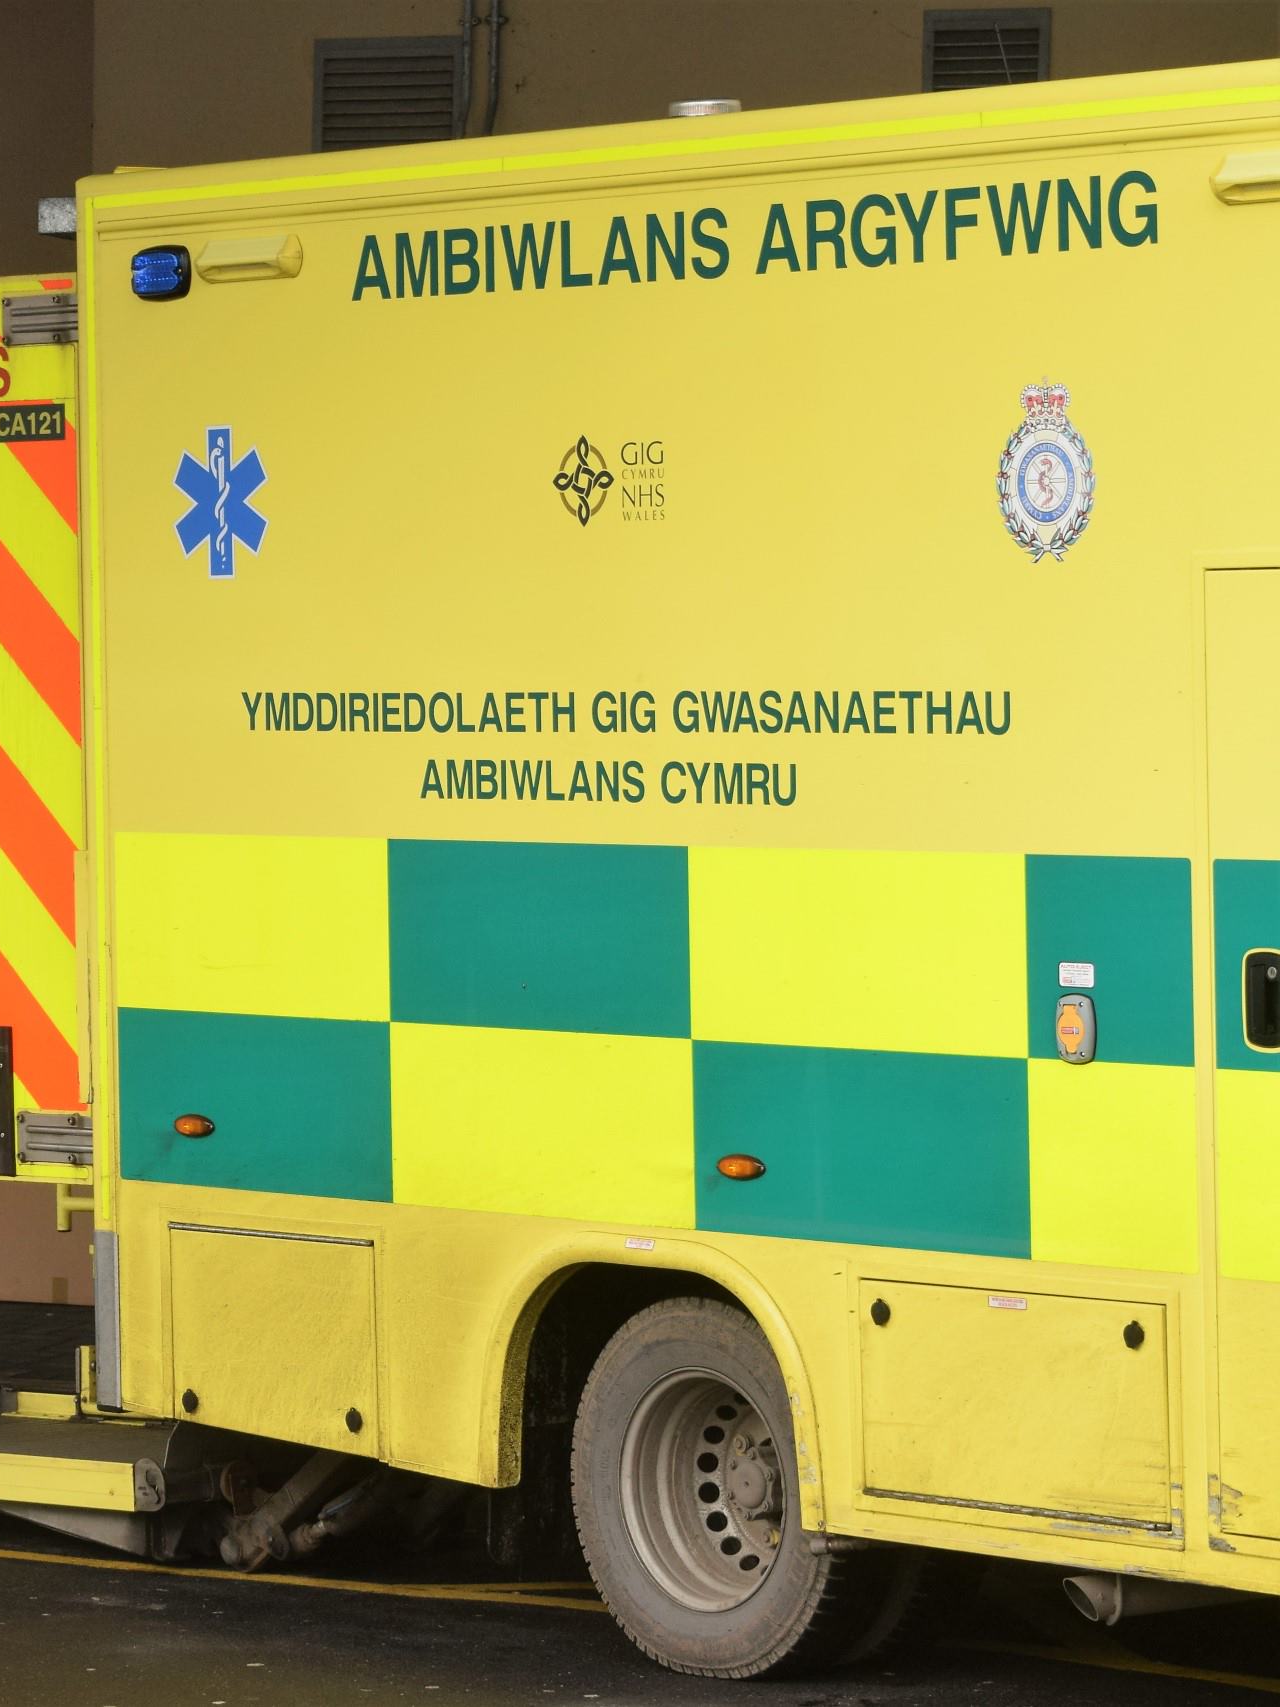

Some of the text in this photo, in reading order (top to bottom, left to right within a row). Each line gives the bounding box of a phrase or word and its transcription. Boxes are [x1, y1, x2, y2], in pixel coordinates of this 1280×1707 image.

[352, 169, 1159, 302] AMBIWLANS ARGYFWNG
[620, 440, 664, 466] GIG
[621, 467, 665, 480] CYMRU
[622, 483, 665, 508] NHS
[622, 509, 665, 522] WALES
[241, 690, 1012, 736] YMDDIRIEDOLAETH GIG GWASANAETHAU
[421, 759, 798, 807] AMBIWLANS CYMRU
